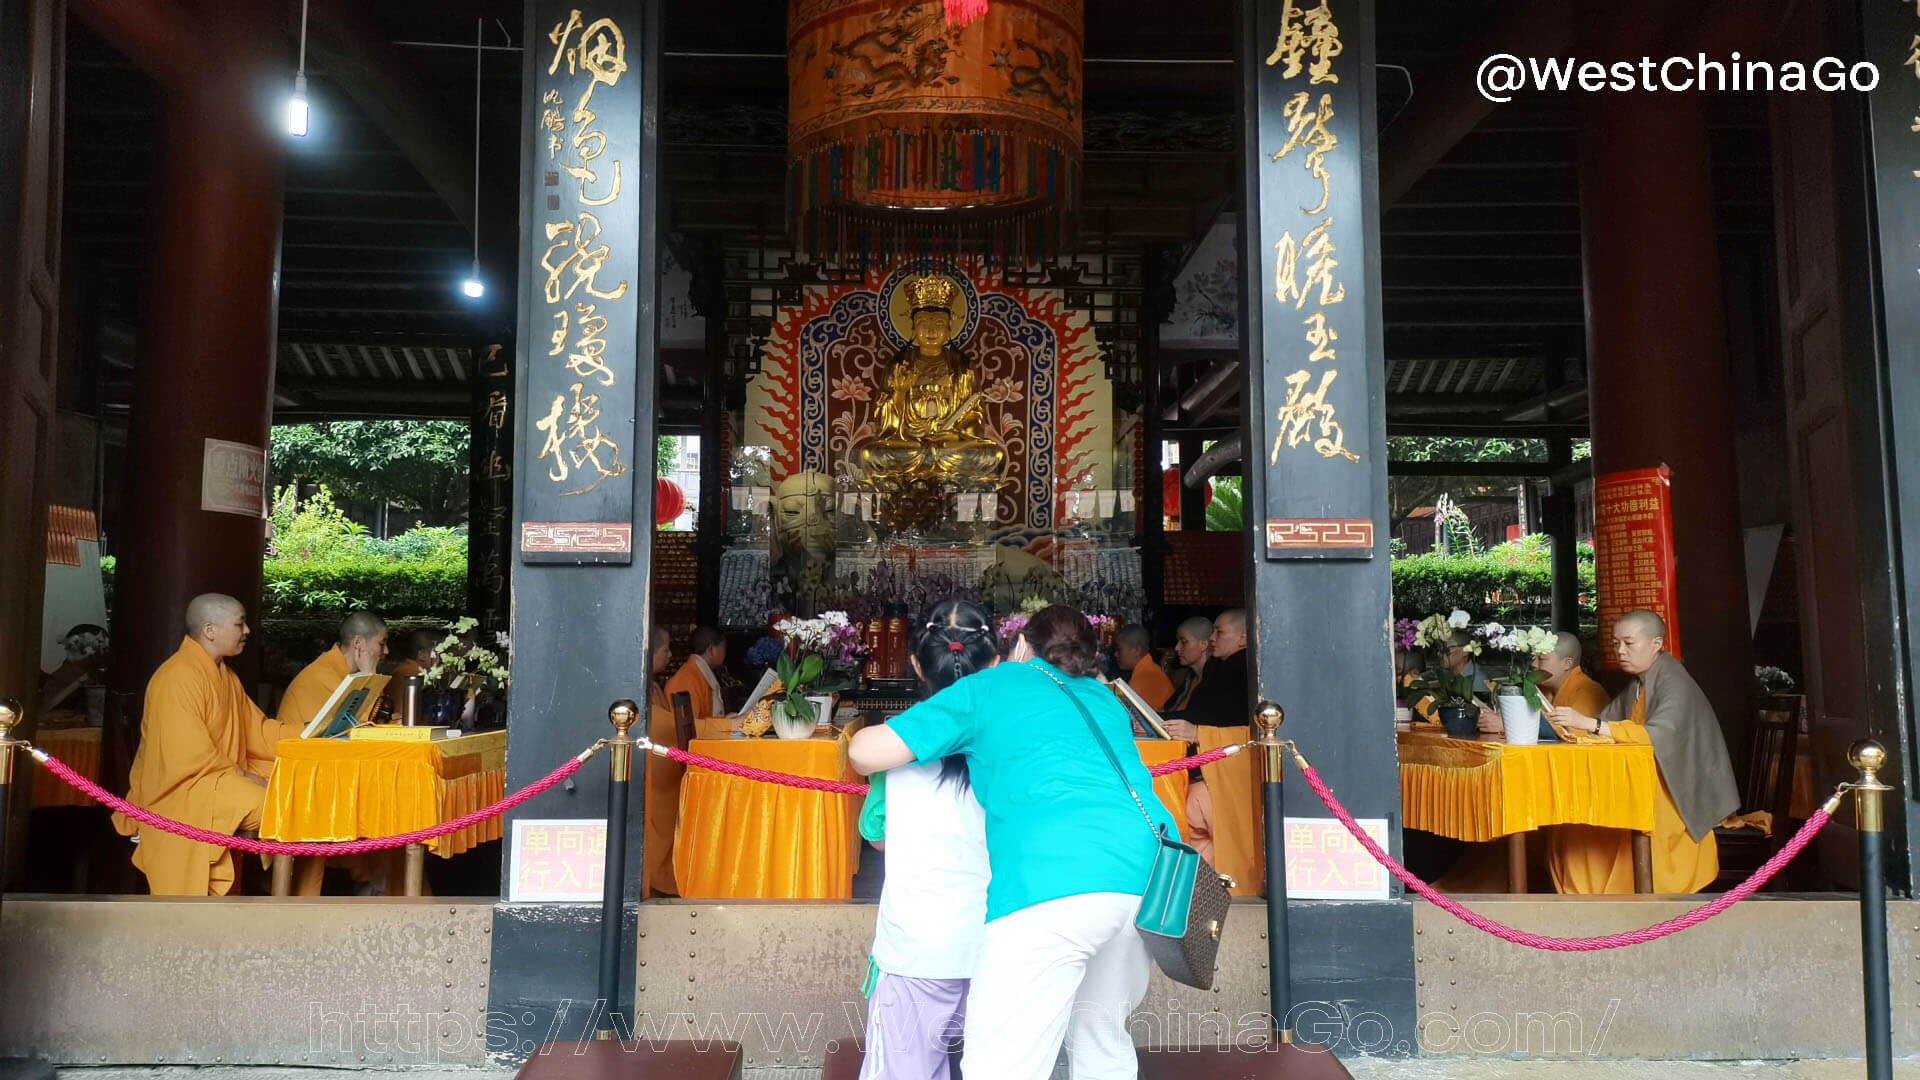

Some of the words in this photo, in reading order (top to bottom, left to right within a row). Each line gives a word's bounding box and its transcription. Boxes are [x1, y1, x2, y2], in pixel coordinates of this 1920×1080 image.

[1597, 496, 1660, 516] 十大功德利益
[1288, 857, 1378, 888] 行入口
